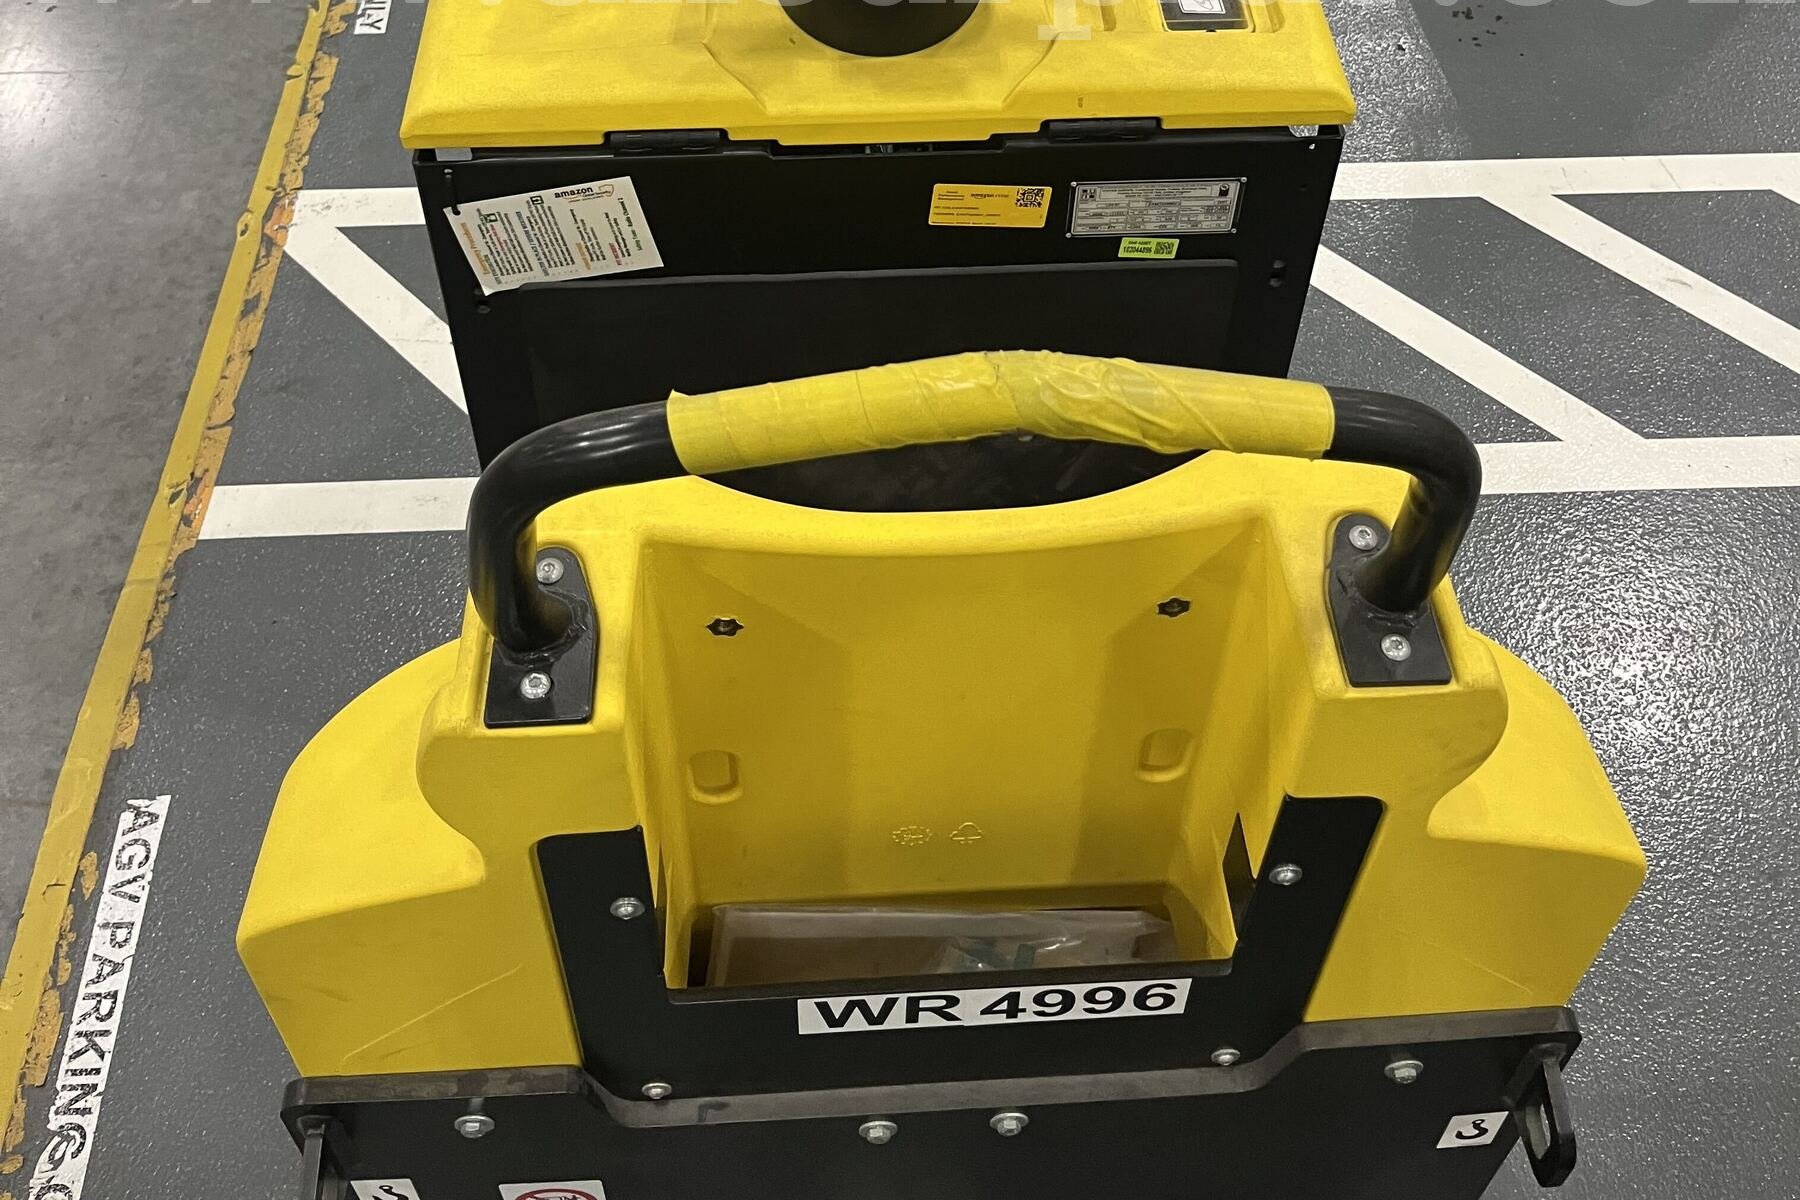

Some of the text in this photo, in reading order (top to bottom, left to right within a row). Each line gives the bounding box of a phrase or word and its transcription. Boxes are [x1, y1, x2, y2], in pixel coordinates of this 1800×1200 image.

[554, 185, 594, 199] amazon
[107, 804, 160, 904] AGV
[48, 920, 136, 1162] PARKING
[814, 982, 1179, 1029] WR 4996
